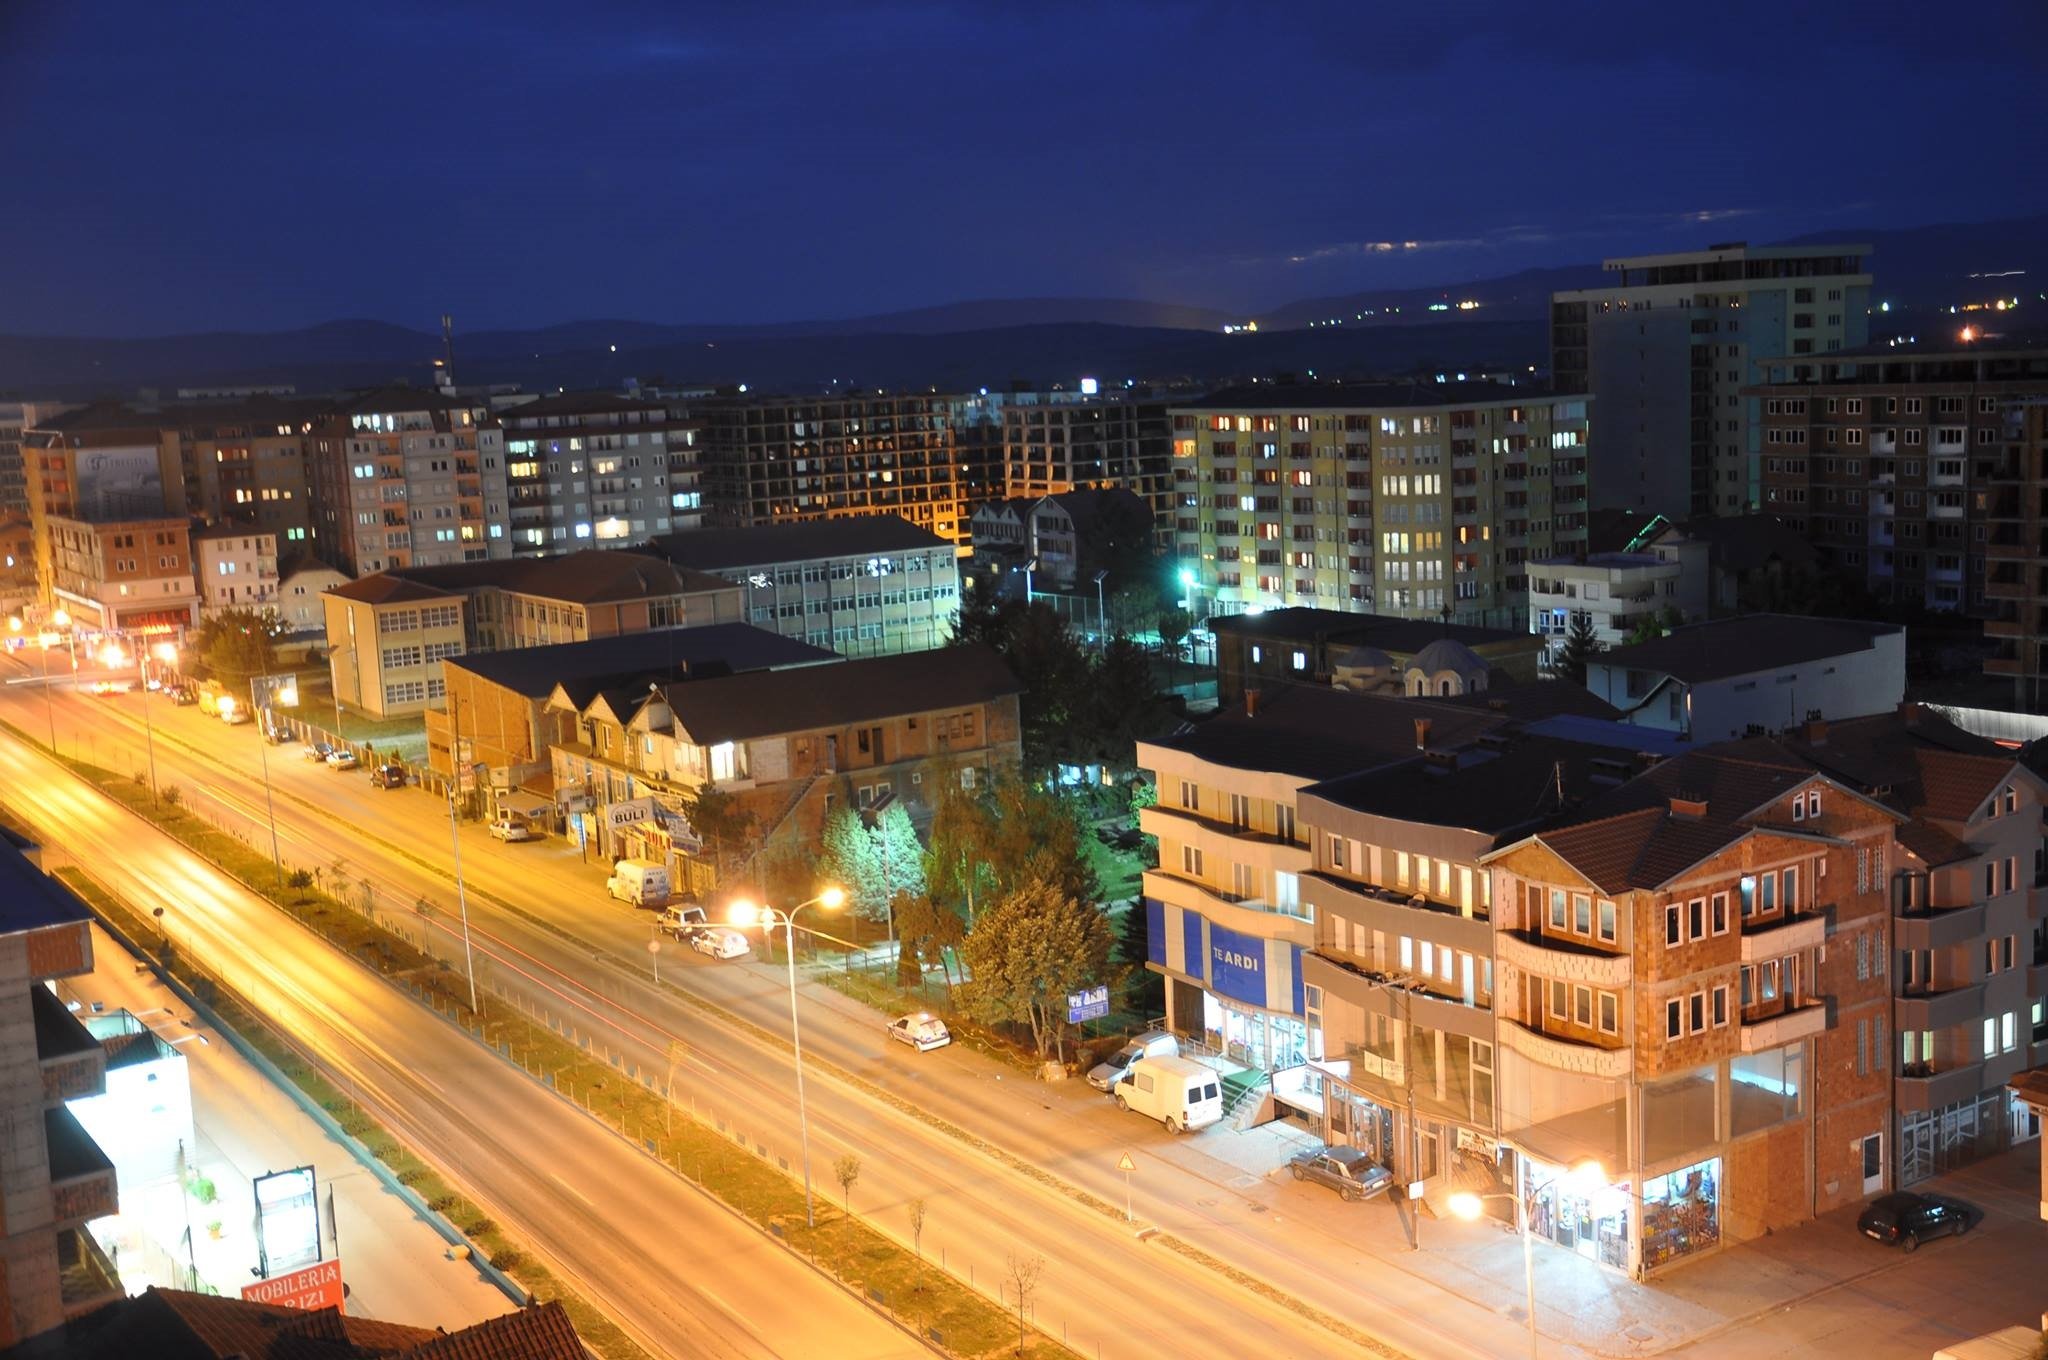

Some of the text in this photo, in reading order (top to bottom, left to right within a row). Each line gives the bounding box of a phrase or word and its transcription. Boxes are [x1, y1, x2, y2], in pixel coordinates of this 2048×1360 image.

[614, 810, 645, 824] BULI
[1213, 946, 1258, 972] TE ARDI
[246, 1264, 338, 1303] MOBILERIA
